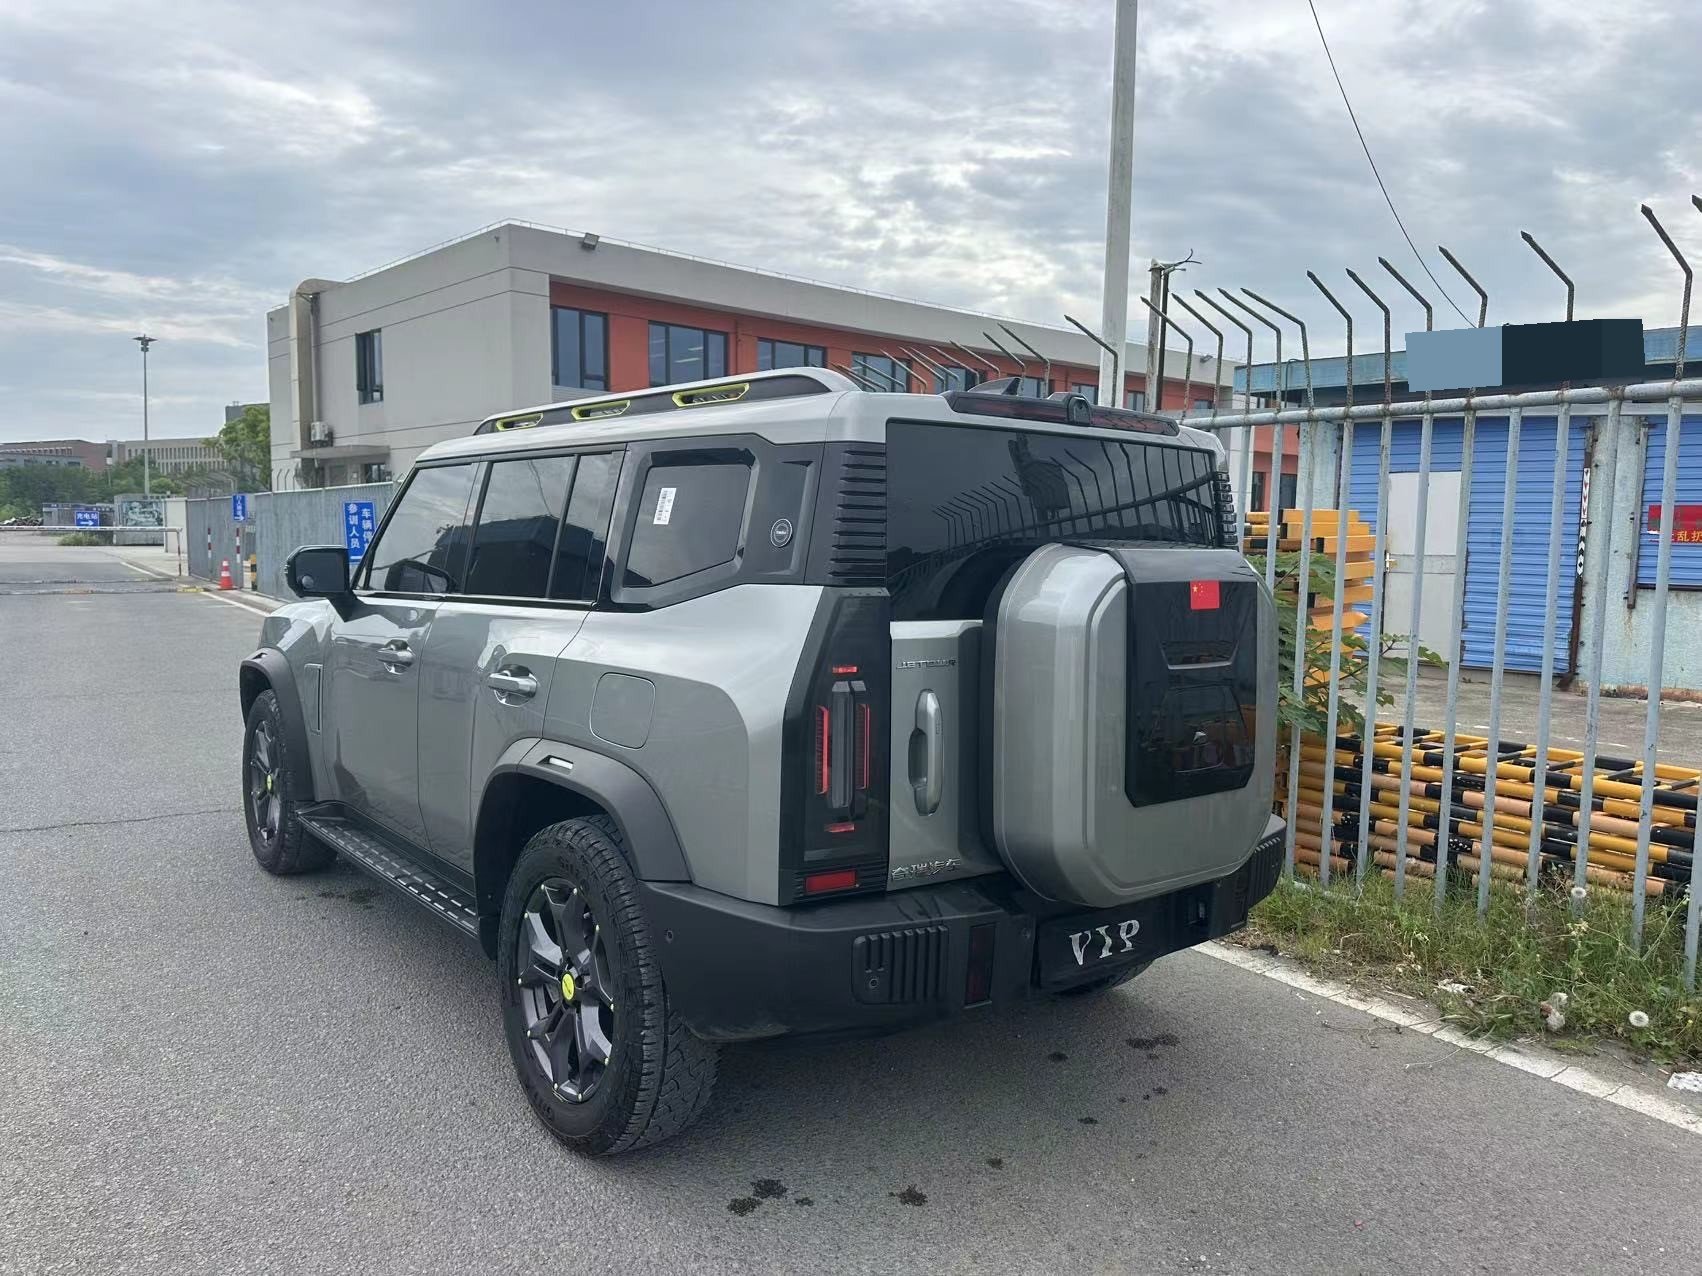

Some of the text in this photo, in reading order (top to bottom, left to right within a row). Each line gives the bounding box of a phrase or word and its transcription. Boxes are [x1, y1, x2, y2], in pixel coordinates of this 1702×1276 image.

[76, 512, 98, 520] 充电站
[347, 503, 360, 549] 参训人员
[361, 508, 373, 552] 车辆停
[1672, 530, 1702, 542] 乱扔
[1068, 919, 1140, 966] VIP
